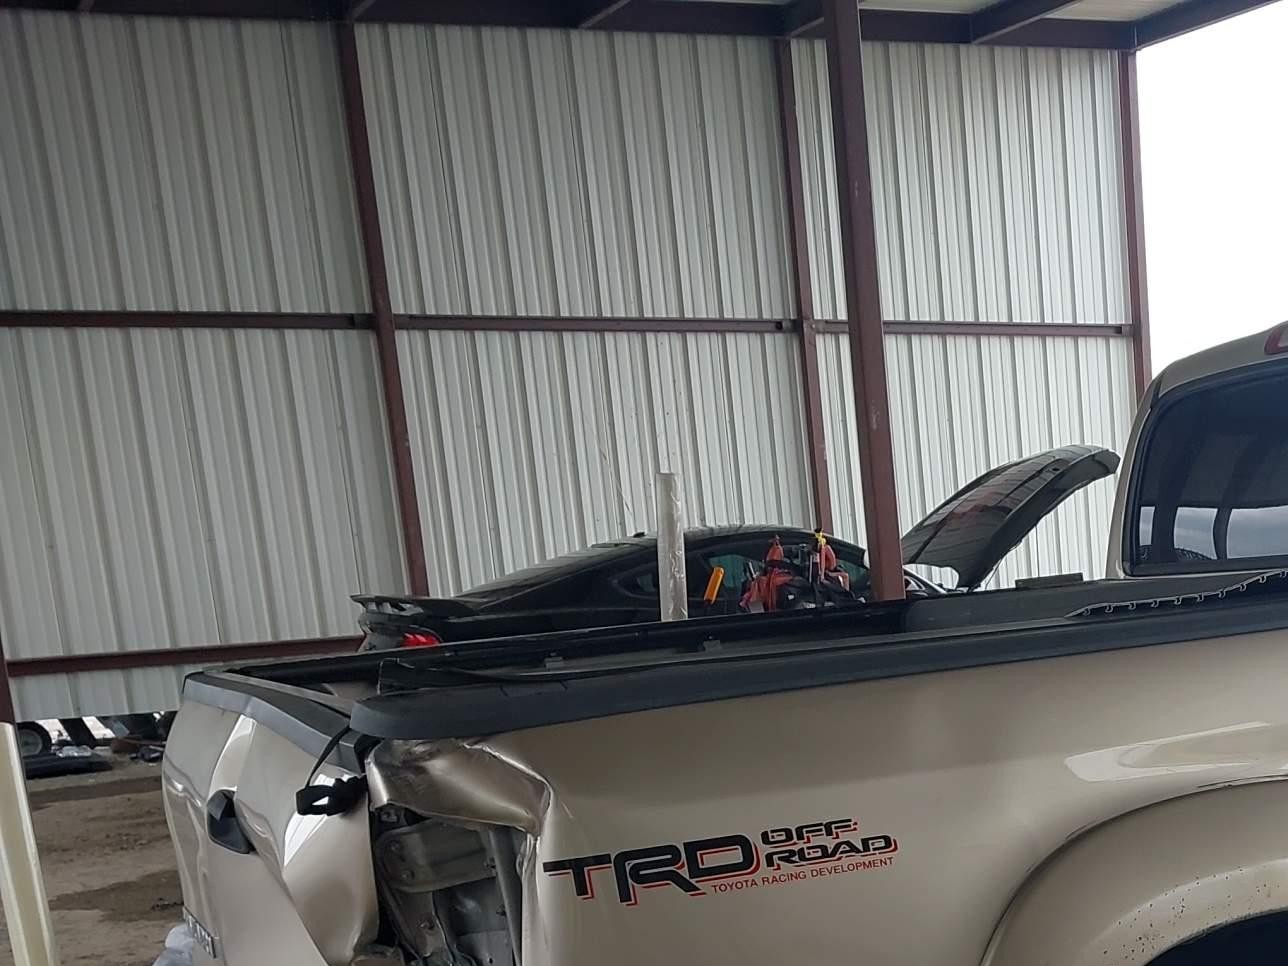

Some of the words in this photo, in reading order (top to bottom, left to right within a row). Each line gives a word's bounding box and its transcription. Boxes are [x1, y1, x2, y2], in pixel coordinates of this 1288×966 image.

[760, 818, 858, 848] OFF
[543, 834, 761, 906] TRD
[764, 834, 898, 871] ROAD
[711, 878, 759, 894] TOYOTA
[762, 870, 807, 887] RACING
[810, 856, 895, 879] DEVELOPMENT
